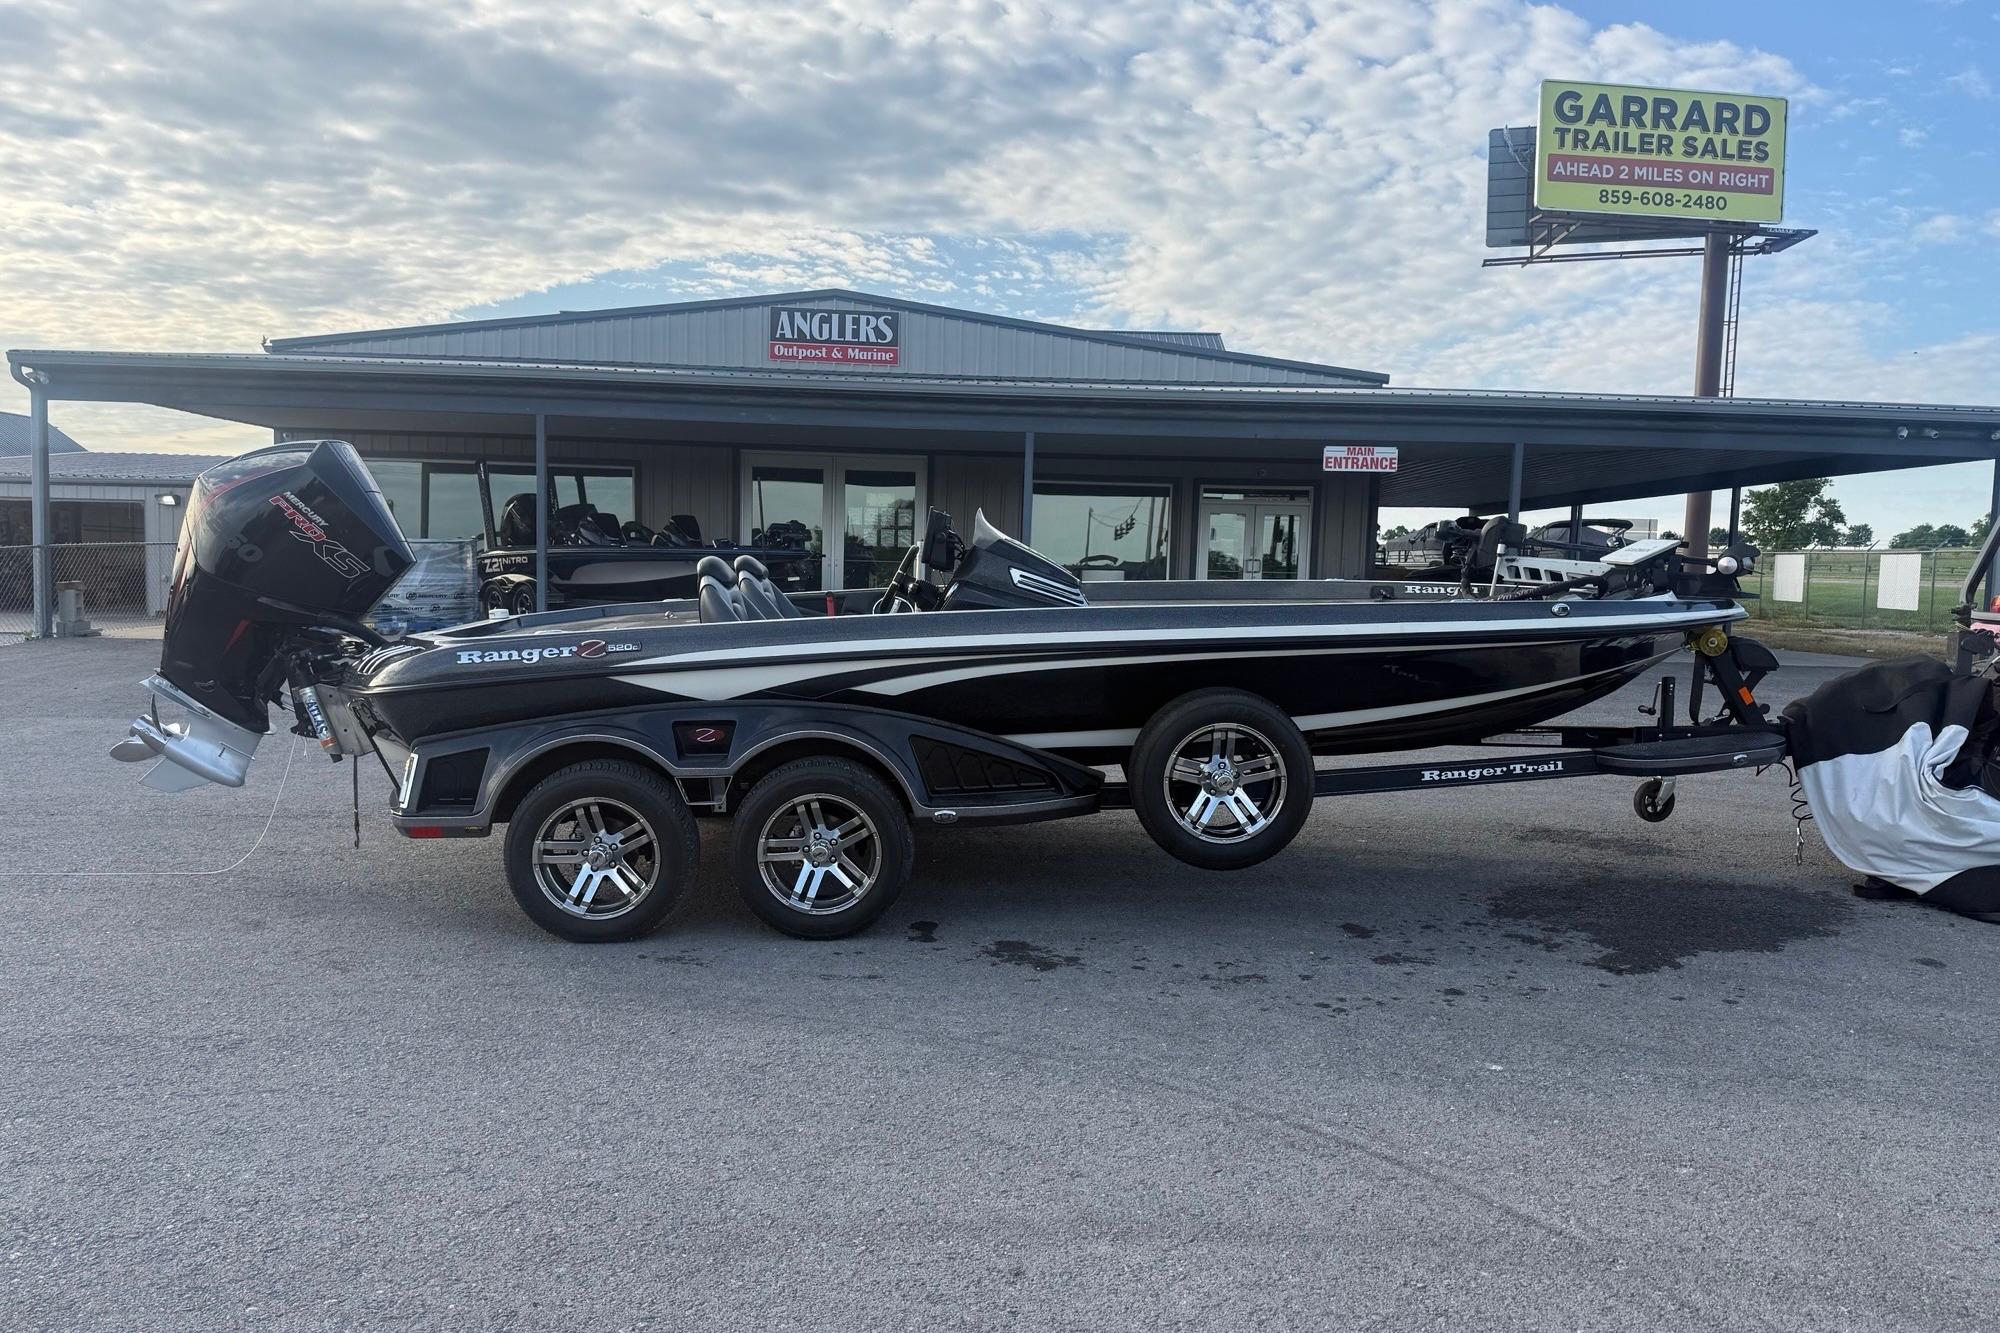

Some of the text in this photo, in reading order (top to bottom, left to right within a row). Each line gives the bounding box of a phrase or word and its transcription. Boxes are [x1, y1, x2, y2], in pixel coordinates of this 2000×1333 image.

[1554, 90, 1771, 137] GARRARD
[1553, 127, 1770, 163] TRAILER SALES
[1553, 161, 1769, 188] AHEAD 2 MILES ON RIGHT
[1599, 189, 1727, 211] 859-608-2480
[775, 311, 894, 343] ANGLERS
[774, 344, 894, 361] Outpost & Marine
[1324, 456, 1397, 470] ENTRANCE
[1346, 447, 1375, 457] MAIN
[269, 495, 326, 542] PRO
[283, 491, 329, 526] MERCURY
[289, 530, 371, 578] XS
[1404, 585, 1479, 597] Rangr
[456, 645, 578, 664] Ranger
[305, 701, 329, 734] ATLAS
[1421, 761, 1564, 781] Ranger Trail
